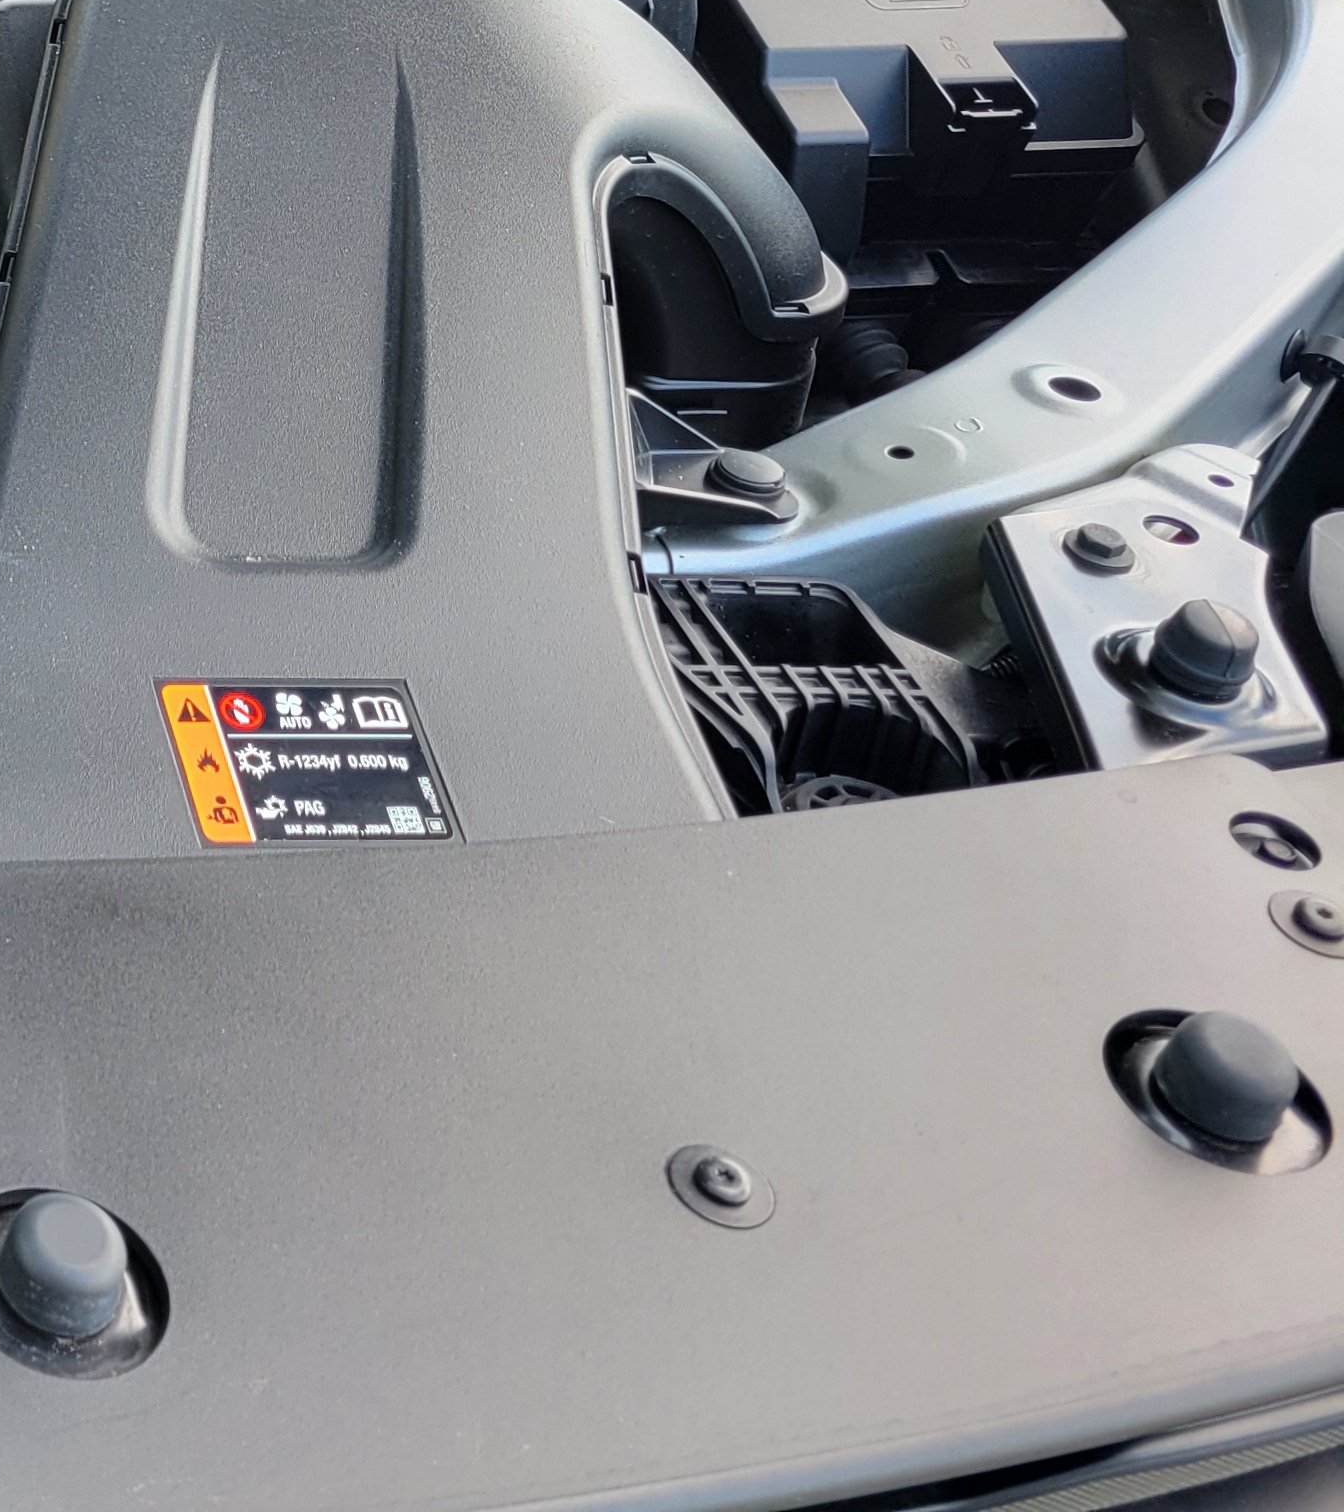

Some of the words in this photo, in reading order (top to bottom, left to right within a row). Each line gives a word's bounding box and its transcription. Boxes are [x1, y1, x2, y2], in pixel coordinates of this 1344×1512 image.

[279, 716, 313, 730] AUTO
[277, 754, 341, 772] R-1234yf
[346, 754, 387, 769] 0.600
[387, 754, 410, 772] kg
[293, 800, 326, 816] PAG
[284, 824, 304, 835] SAE
